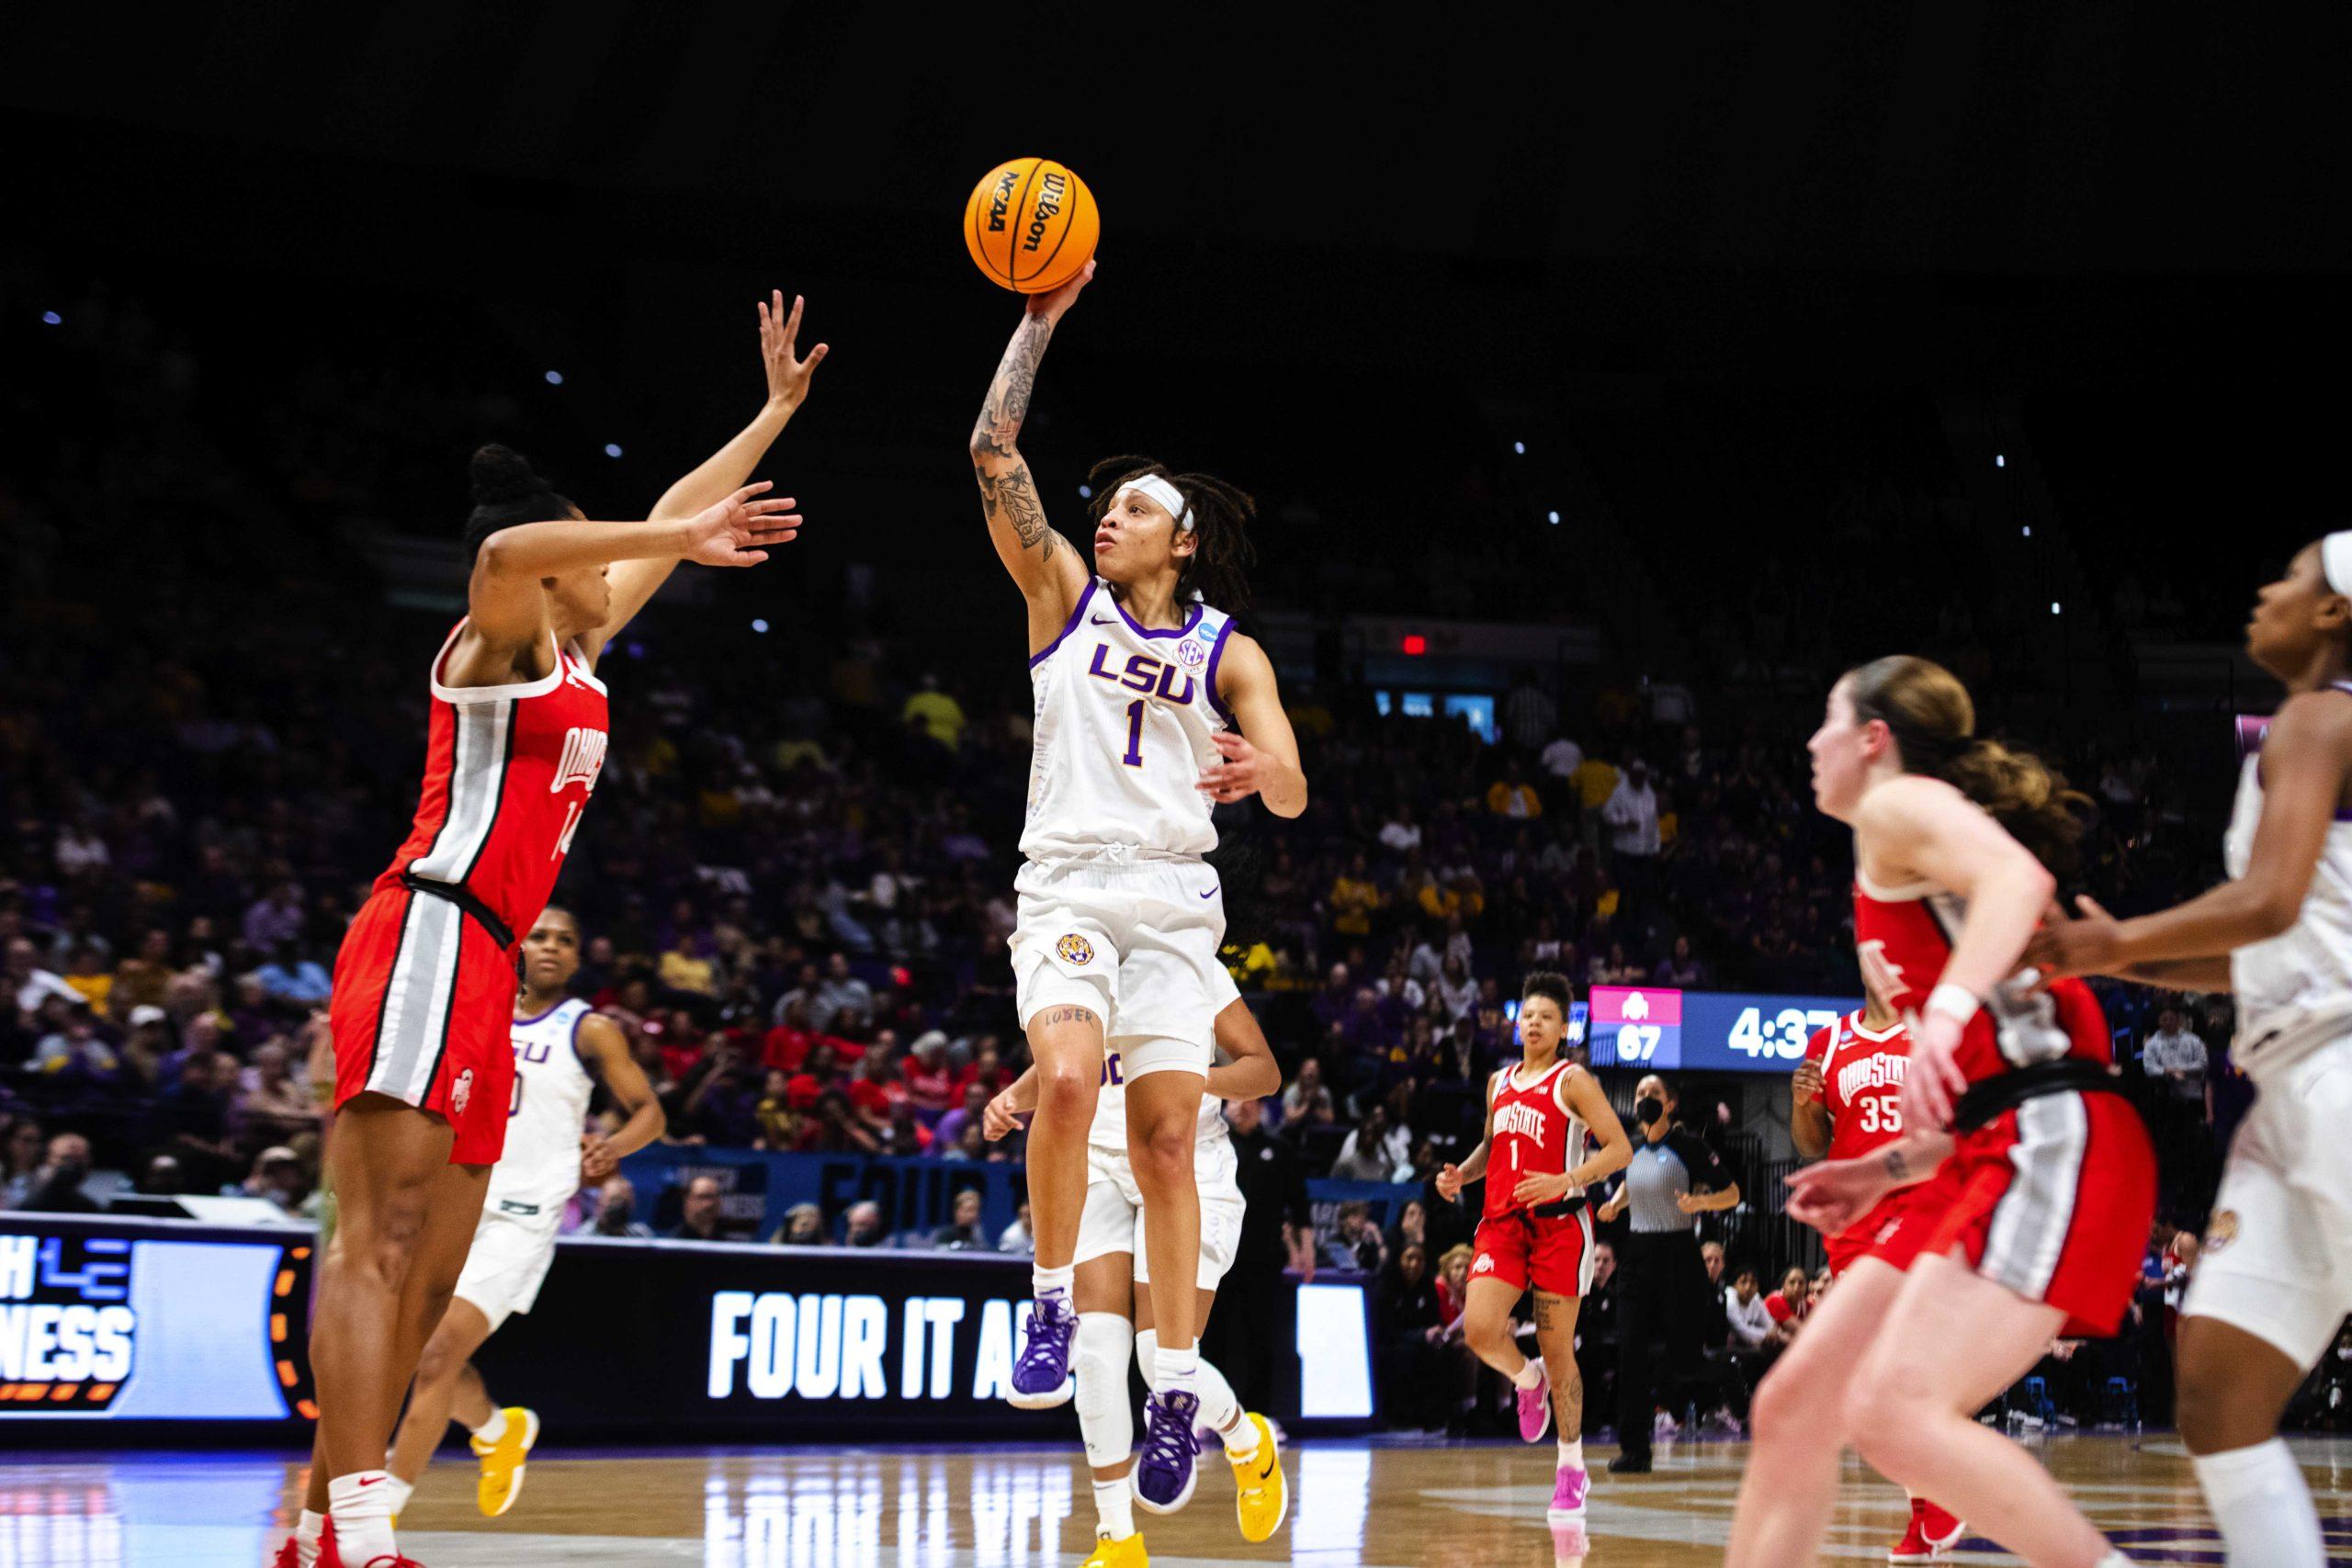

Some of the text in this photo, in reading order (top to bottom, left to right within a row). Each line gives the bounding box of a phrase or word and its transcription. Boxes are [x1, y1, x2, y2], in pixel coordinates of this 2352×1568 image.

[989, 171, 1020, 232] NCAA
[1023, 171, 1066, 253] Wilson
[1089, 643, 1193, 705] LSU
[1180, 640, 1204, 664] SEC
[1123, 699, 1145, 769] 1
[1617, 1024, 1661, 1061] 67
[1860, 1095, 1903, 1133] 35
[1510, 1139, 1519, 1171] 1
[707, 1290, 888, 1400] FOUR
[901, 1295, 966, 1400] IT
